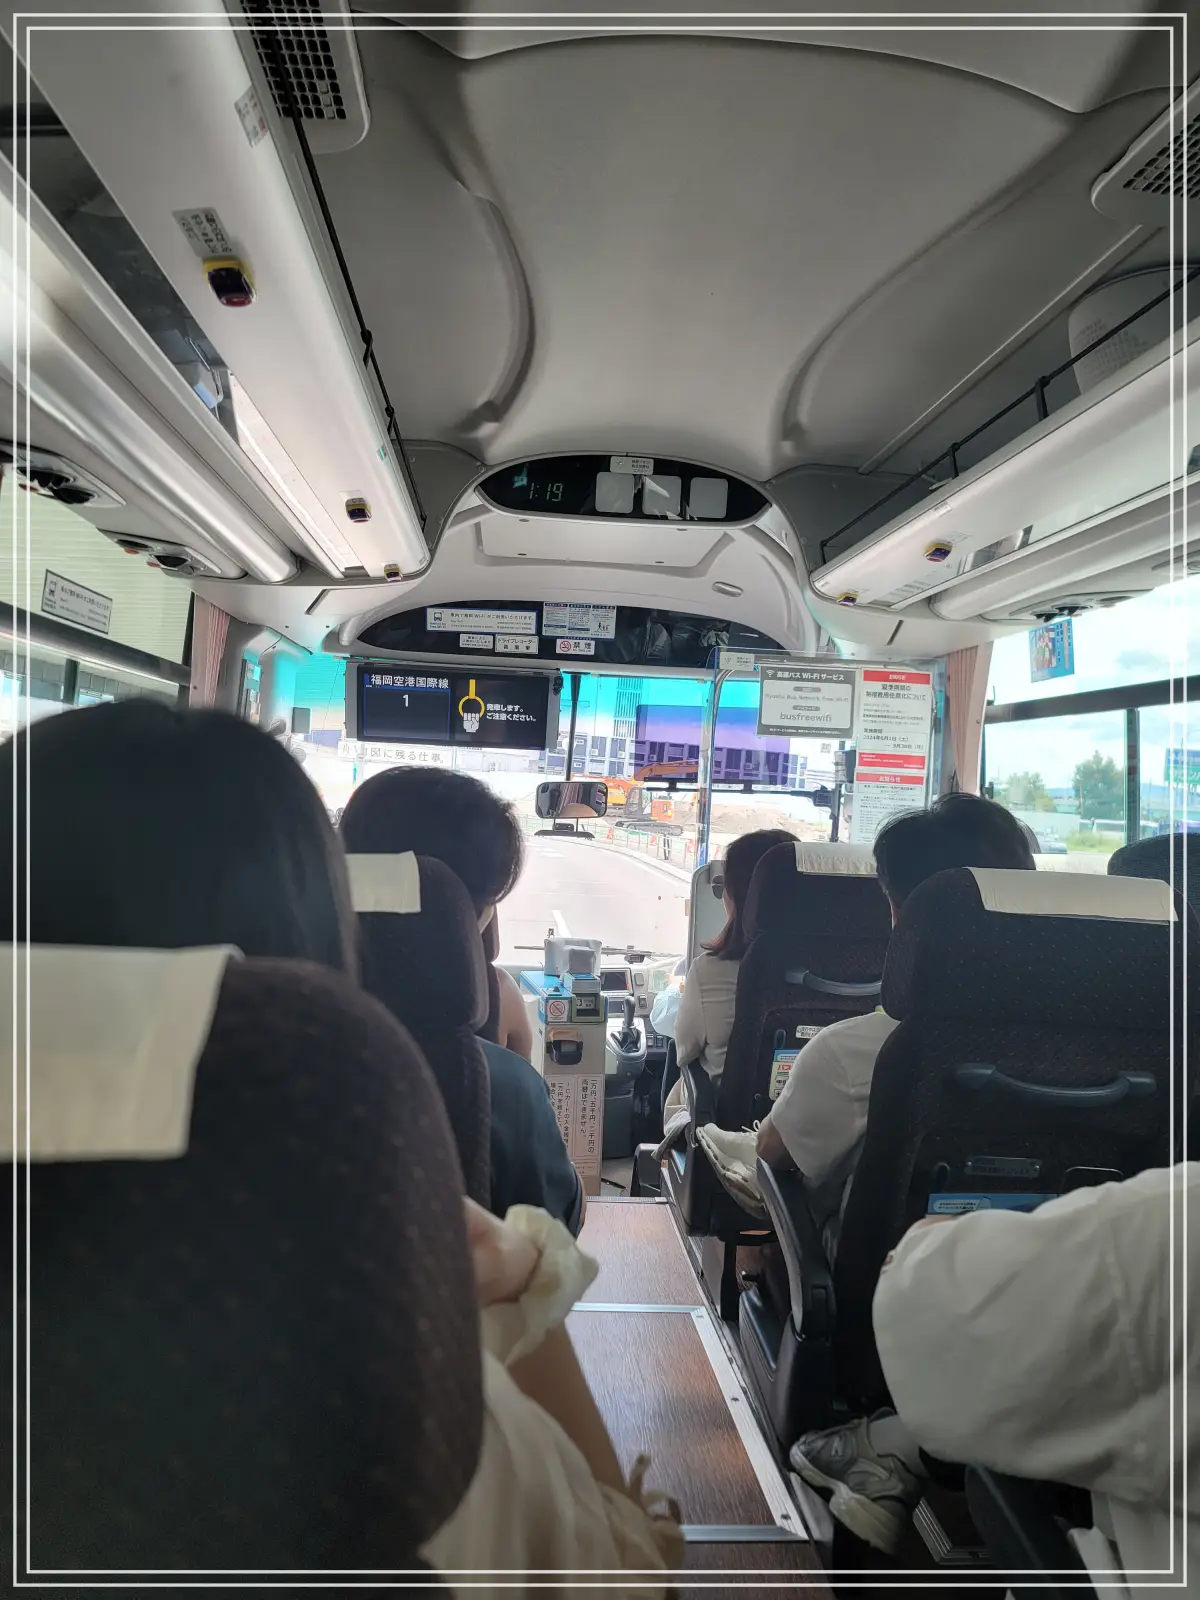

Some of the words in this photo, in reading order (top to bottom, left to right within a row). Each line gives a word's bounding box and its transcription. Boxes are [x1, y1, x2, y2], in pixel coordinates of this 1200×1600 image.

[370, 673, 449, 689] 福岡空港国際線
[802, 672, 820, 680] Wi-Fi
[820, 673, 845, 681] サービス
[402, 694, 409, 708] 1
[486, 712, 537, 722] ご注意ください。
[780, 711, 832, 722] busfreewifi
